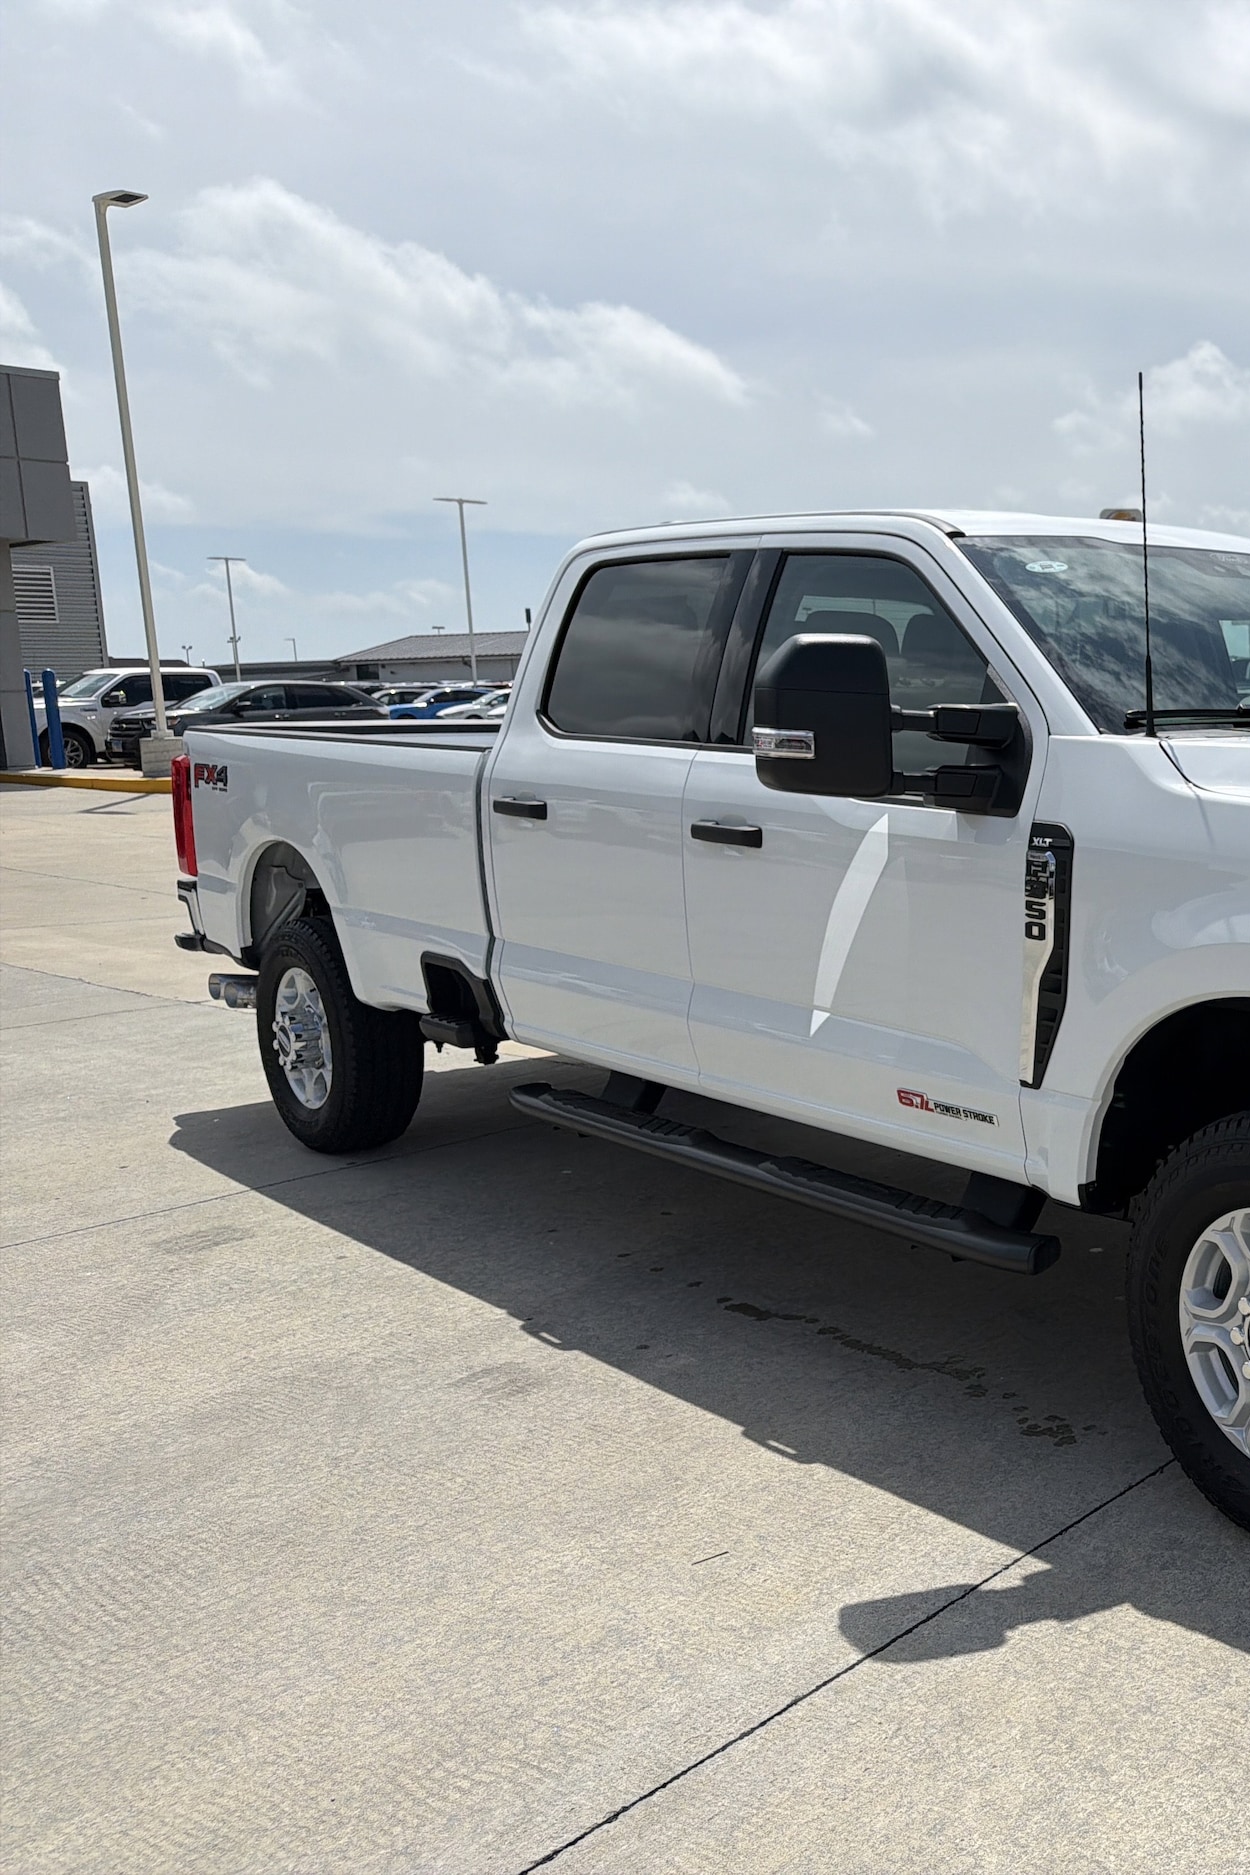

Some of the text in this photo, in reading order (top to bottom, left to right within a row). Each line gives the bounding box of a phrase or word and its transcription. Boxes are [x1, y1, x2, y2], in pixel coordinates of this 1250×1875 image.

[194, 763, 228, 788] FX4
[1032, 836, 1053, 847] XLT
[897, 1089, 935, 1113] 6.7L
[933, 1102, 962, 1117] POWER
[962, 1109, 995, 1125] STROKE
